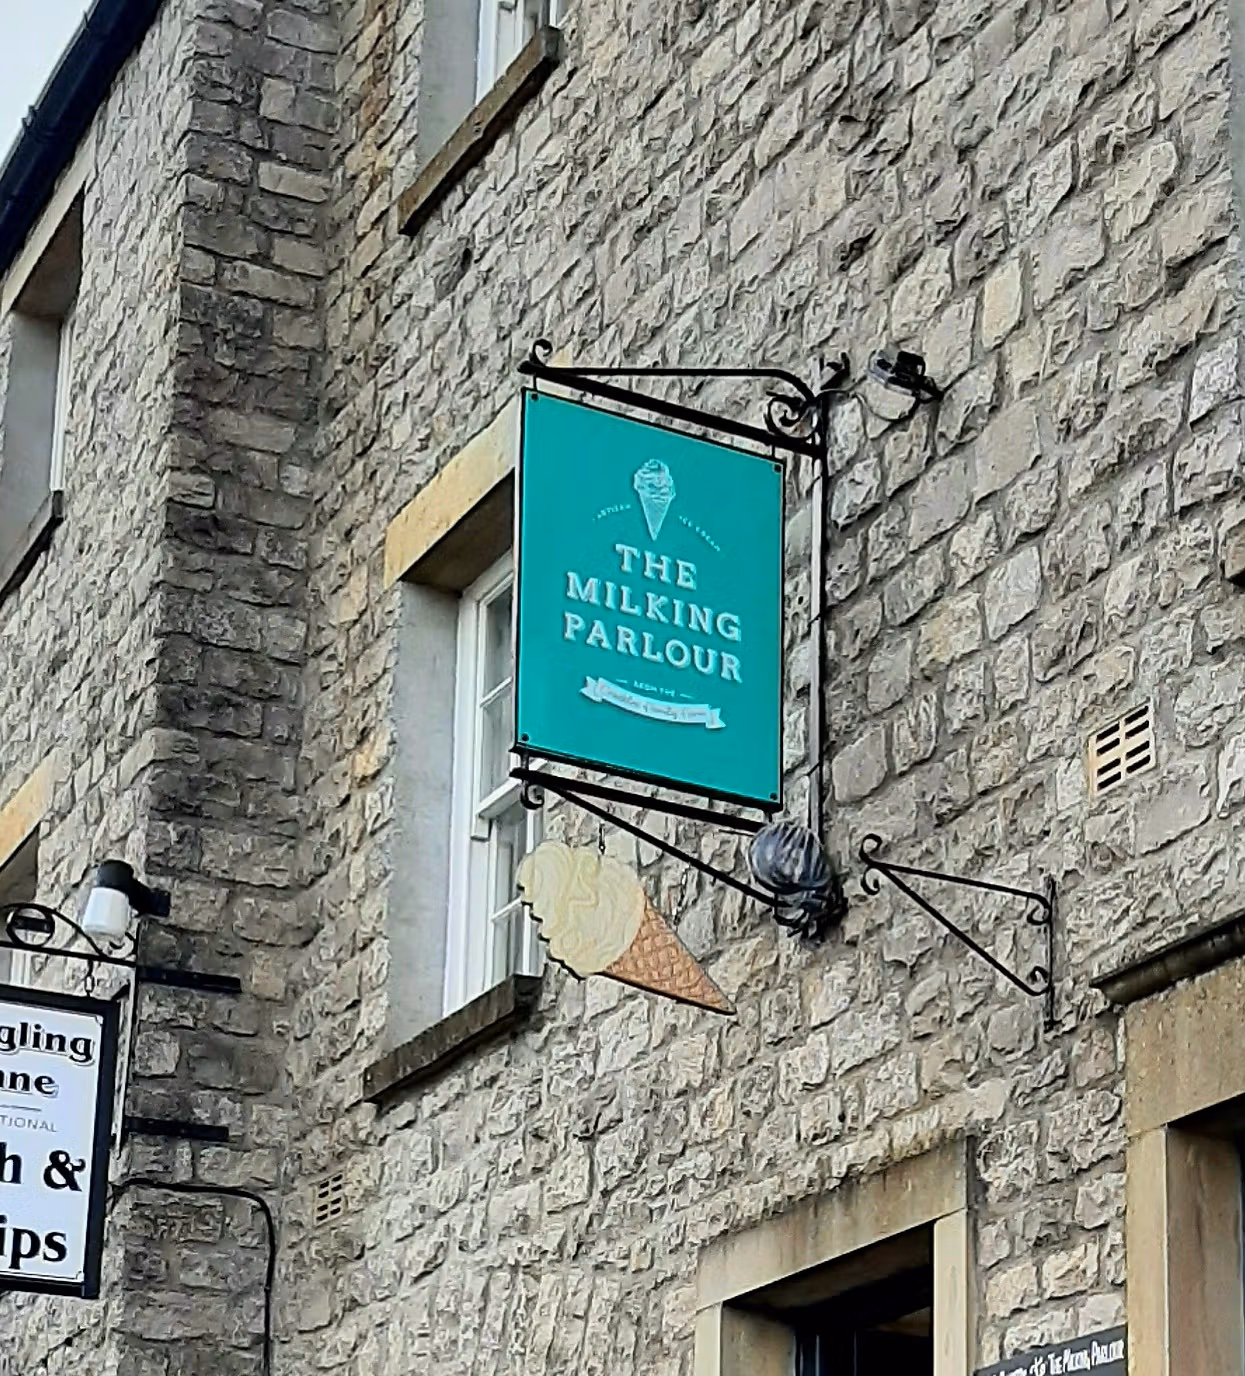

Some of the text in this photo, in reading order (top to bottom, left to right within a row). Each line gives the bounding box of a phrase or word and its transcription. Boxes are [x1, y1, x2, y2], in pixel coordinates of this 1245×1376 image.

[615, 543, 697, 590] THE
[566, 571, 742, 642] MILKING
[564, 611, 743, 683] PARLOUR
[0, 1022, 92, 1063] gling
[0, 1114, 58, 1133] TIONAL
[43, 1149, 87, 1192] &
[0, 1214, 67, 1270] ips
